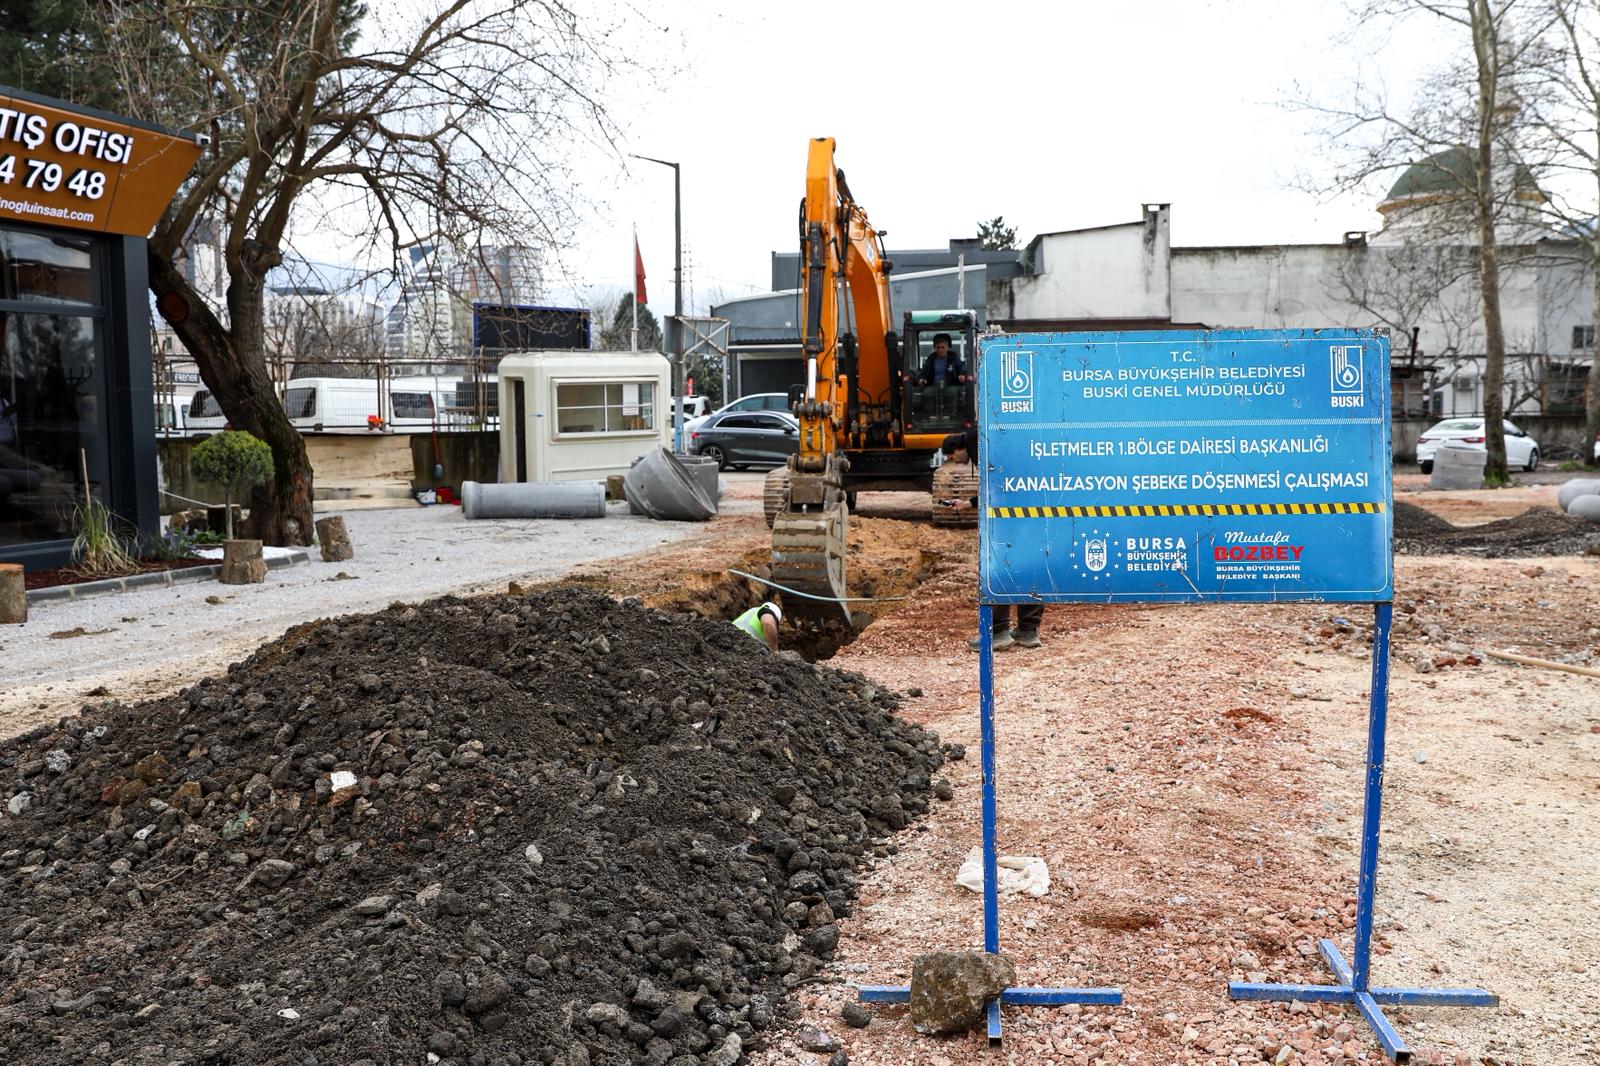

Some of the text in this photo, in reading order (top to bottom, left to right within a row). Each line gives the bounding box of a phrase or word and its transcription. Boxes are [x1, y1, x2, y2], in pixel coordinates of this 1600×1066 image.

[0, 108, 47, 150] TIŞ
[0, 155, 106, 200] 4 79 48
[1170, 351, 1196, 362] T.C.
[1063, 363, 1306, 382] BURSA BÜYÜKŞEHİR BELEDİYESİ
[1083, 381, 1286, 398] BUSKİ GENEL MÜDÜRLÜĞÜ
[1001, 398, 1034, 413] BUSKİ
[1331, 393, 1365, 408] BUSKİ
[1030, 434, 1329, 460] İŞLETMELER 1.BÖLGE DAİRESİ BAŞKANLIĞI
[1004, 470, 1369, 494] KANALİZASYON ŞEBEKE DÖŞENMESİ ÇALIŞMASI
[1126, 537, 1187, 550] BURSA
[1224, 531, 1290, 545] Mustafa
[1126, 551, 1187, 564] BÜYÜKŞEHİR
[1213, 546, 1305, 561] BOZBEY
[1127, 561, 1188, 572] BELEDİYESİ
[1246, 563, 1301, 572] BÜYÜKŞEHİR
[1216, 572, 1301, 580] BELEDİYE BAŞKANI
